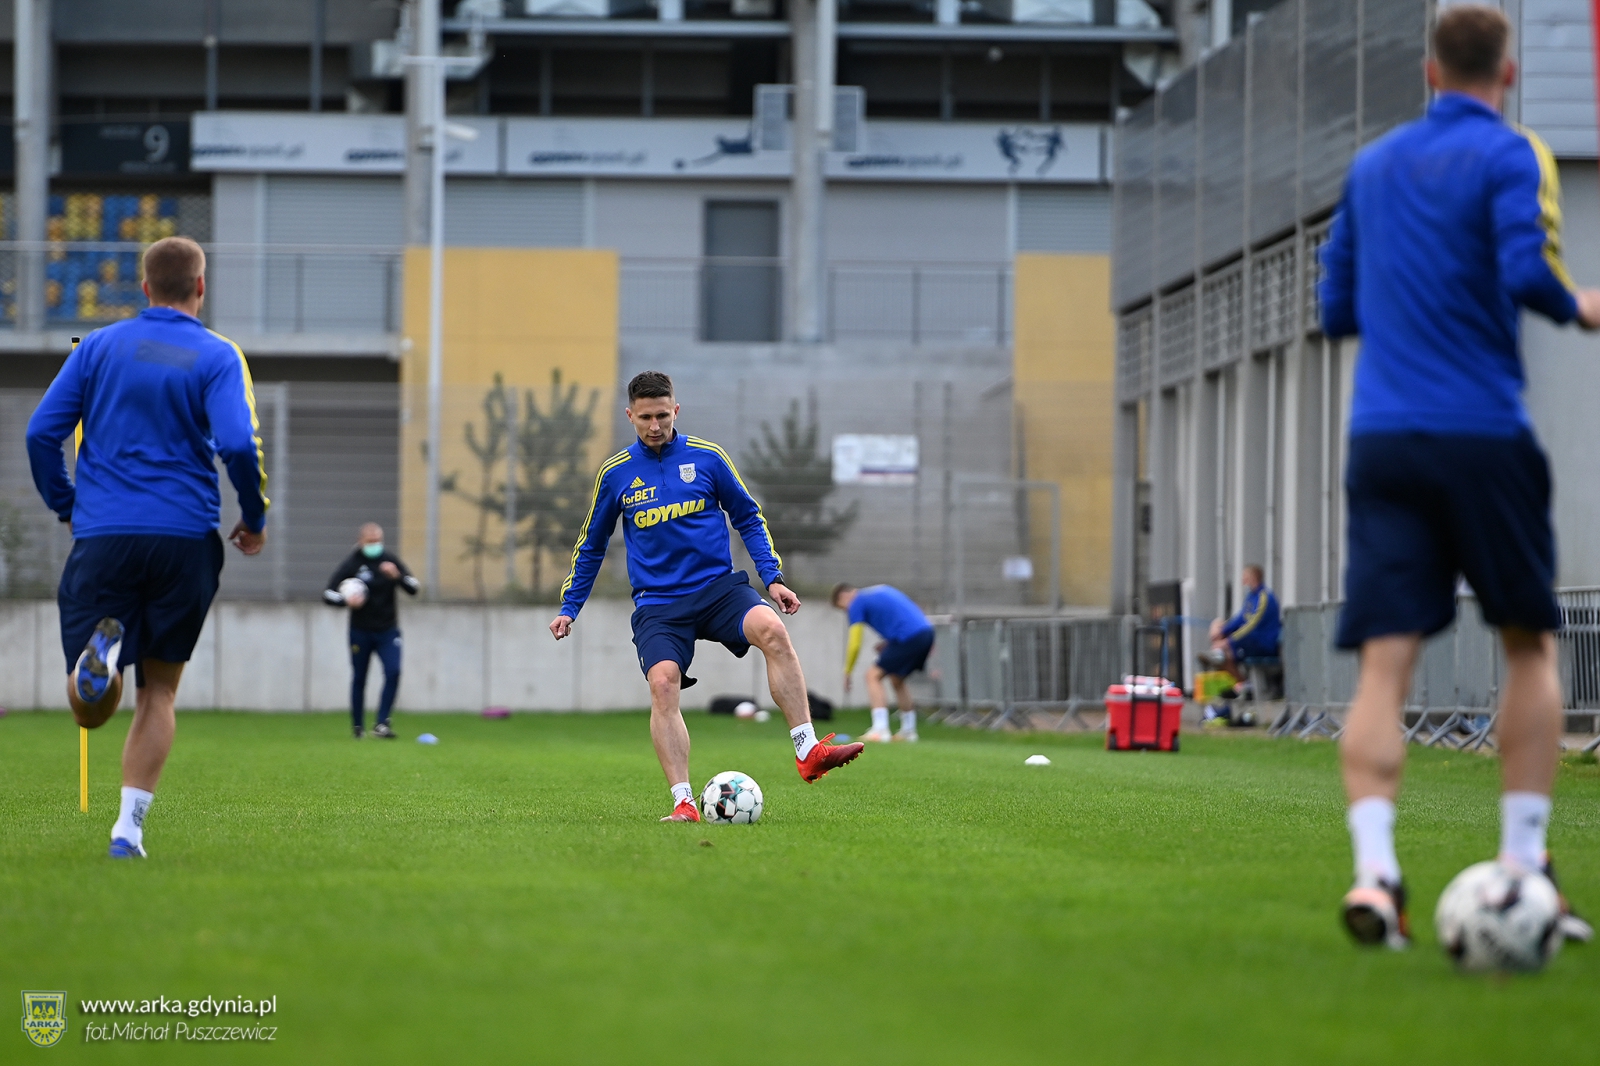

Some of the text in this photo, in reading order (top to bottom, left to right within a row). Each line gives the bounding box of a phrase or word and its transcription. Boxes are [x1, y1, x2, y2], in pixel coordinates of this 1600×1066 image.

[144, 124, 169, 163] 9
[622, 486, 657, 505] forBET
[634, 498, 706, 529] GDYNIA
